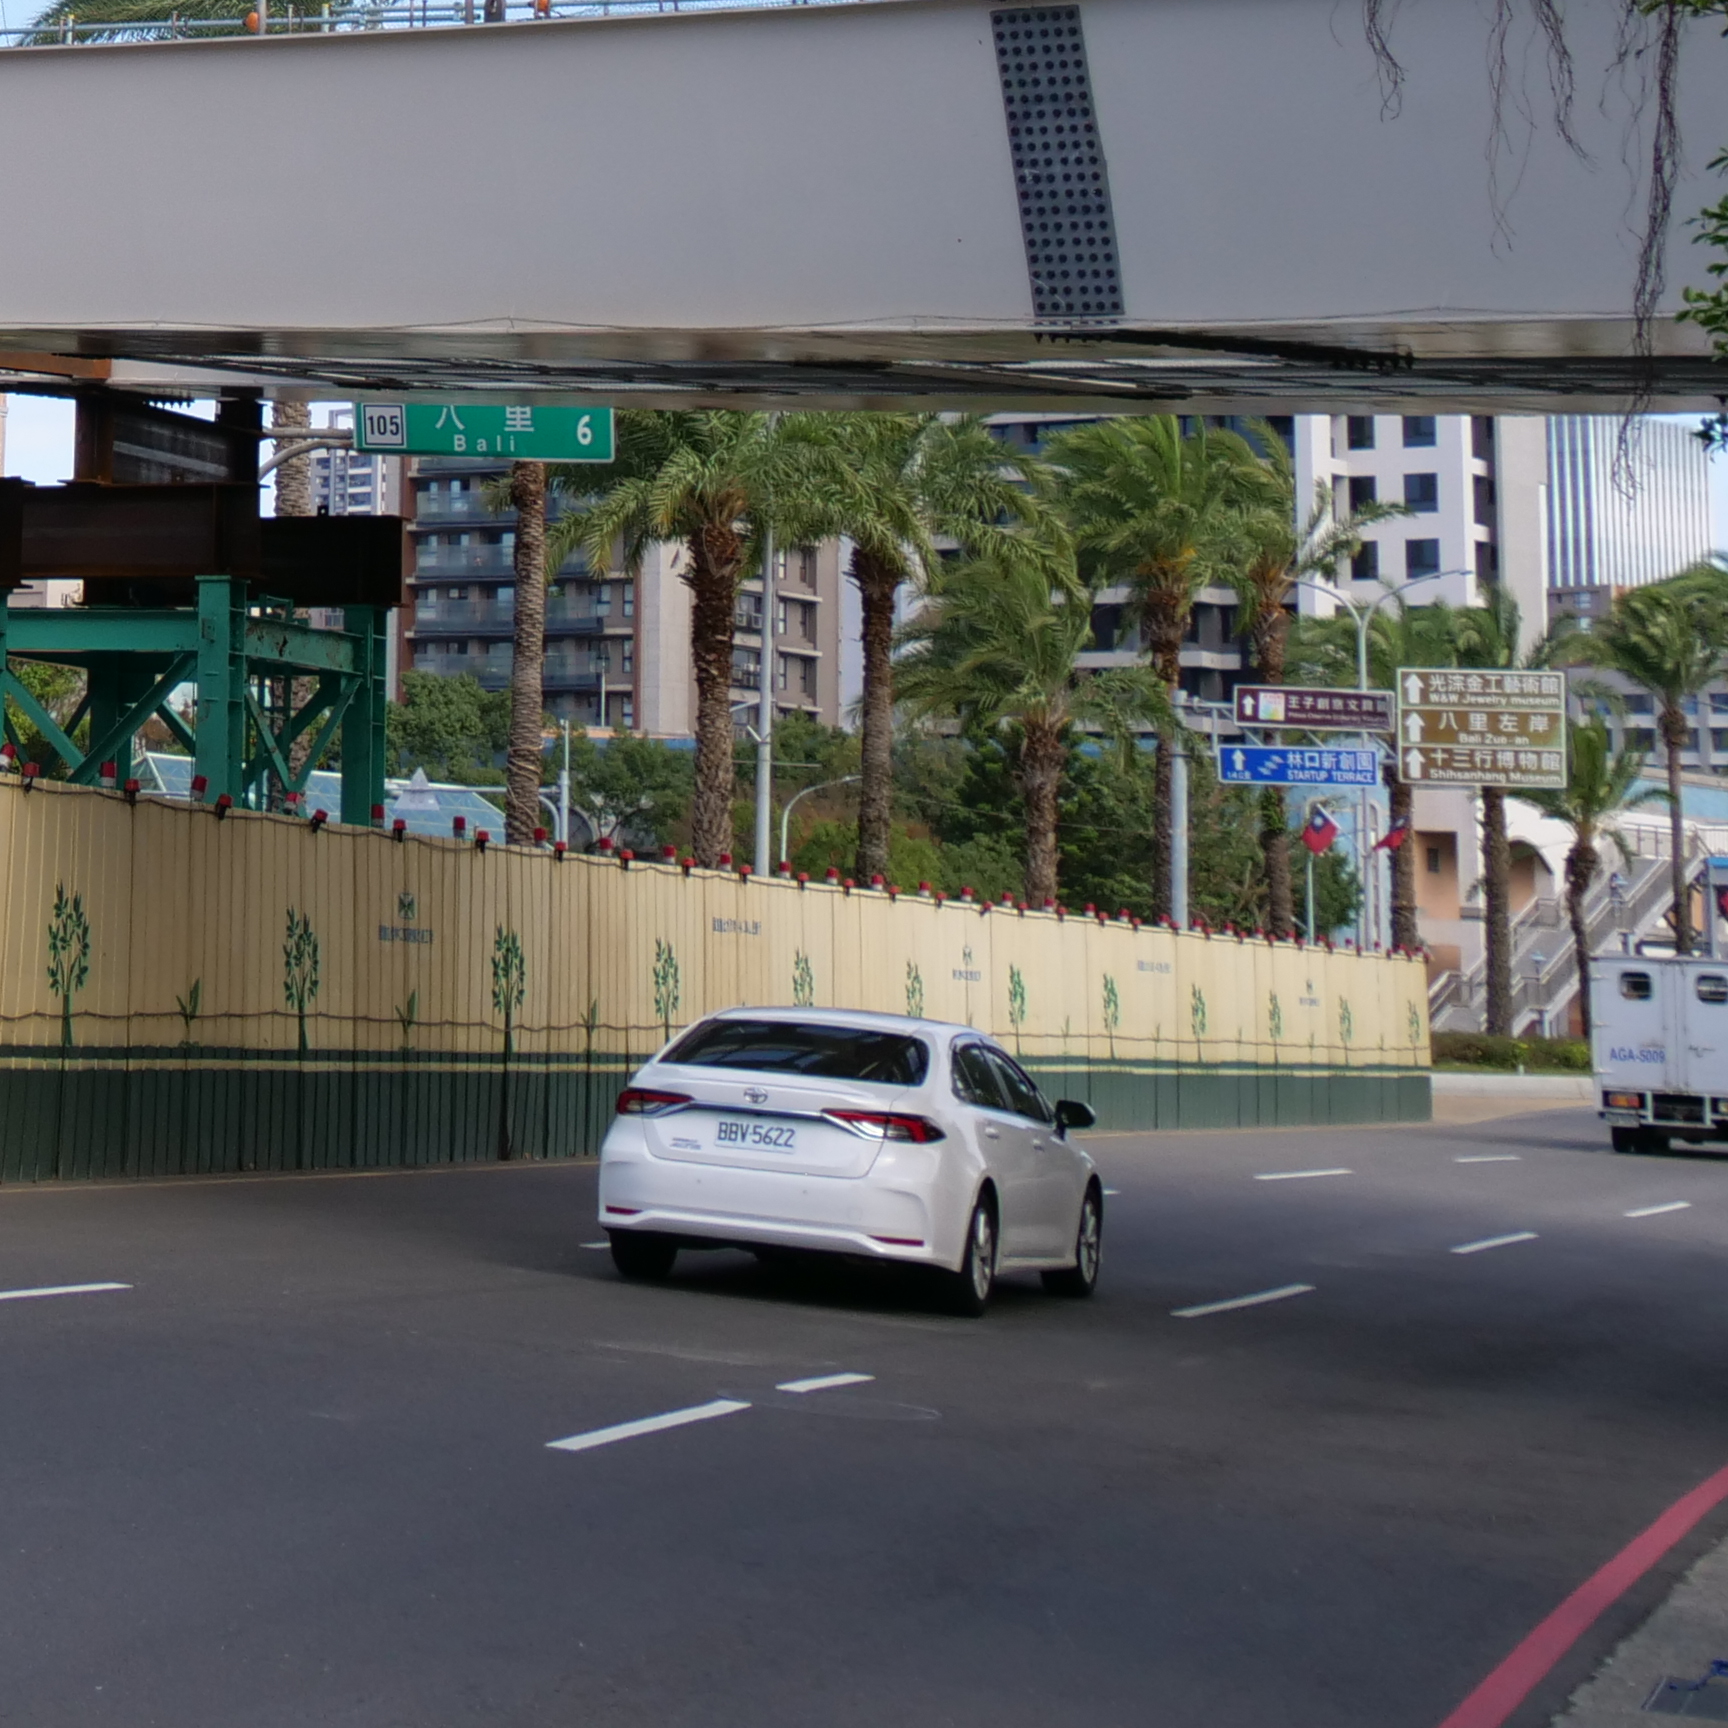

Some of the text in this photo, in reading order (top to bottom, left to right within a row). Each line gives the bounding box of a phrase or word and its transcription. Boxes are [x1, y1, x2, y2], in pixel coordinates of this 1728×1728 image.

[367, 415, 400, 436] 105
[434, 404, 535, 433] 八里
[576, 414, 593, 446] 6
[453, 434, 515, 452] Bali
[1428, 692, 1559, 706] W&W Jewelry museum
[1438, 711, 1549, 733] 八里左岸
[1459, 733, 1482, 744] Bali
[1287, 752, 1374, 771] 林口新創園
[1430, 749, 1561, 771] 十三行博物館
[1287, 770, 1374, 783] STARTUP TERRACE
[1510, 773, 1562, 784] Museum
[1609, 1047, 1665, 1063] AGA-5009
[717, 1122, 796, 1148] BBV-5622
